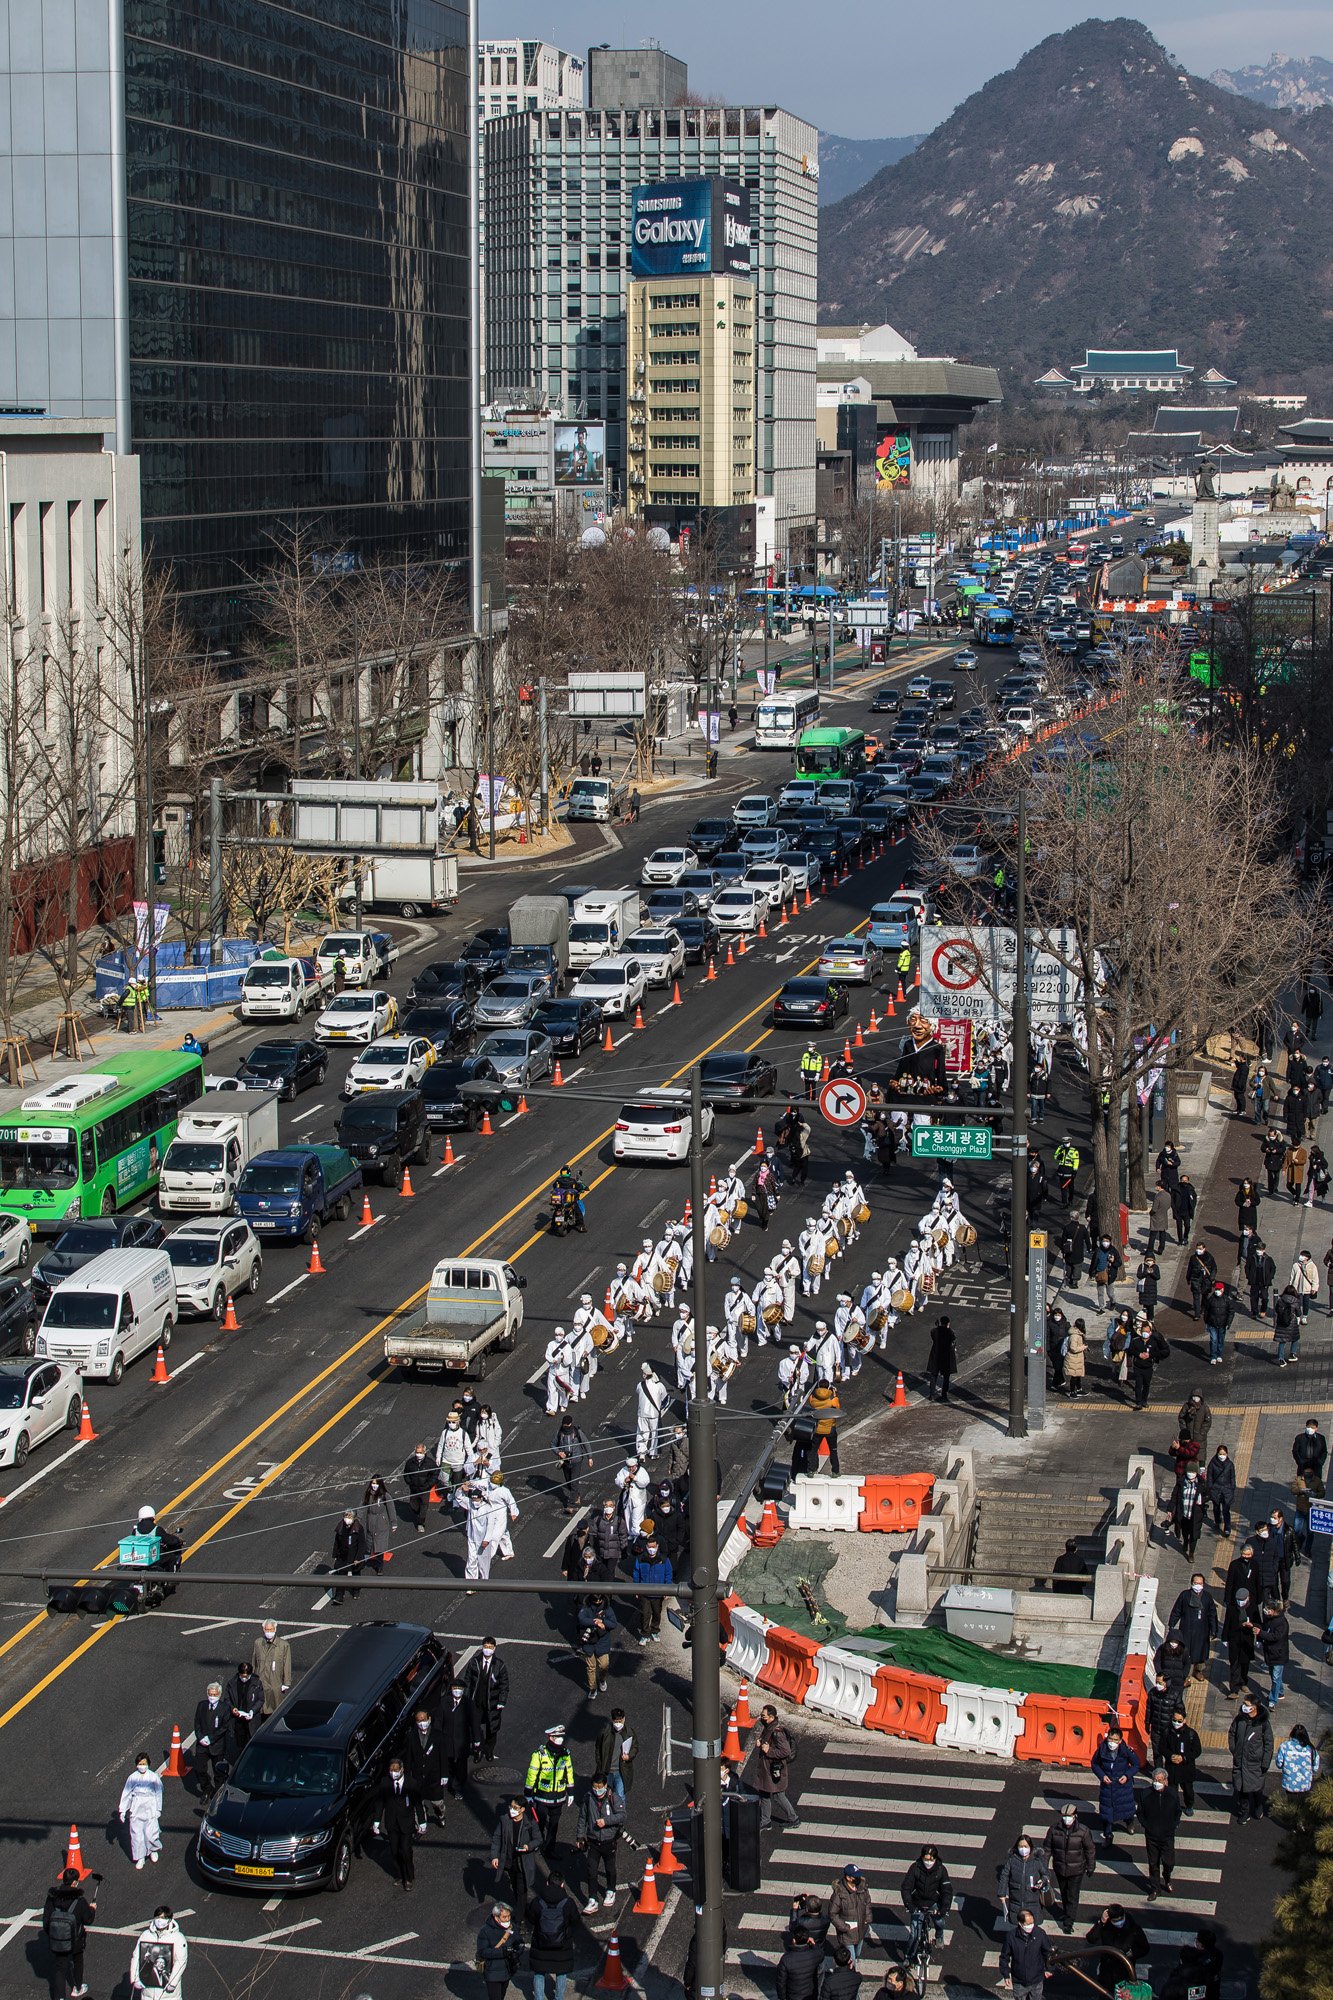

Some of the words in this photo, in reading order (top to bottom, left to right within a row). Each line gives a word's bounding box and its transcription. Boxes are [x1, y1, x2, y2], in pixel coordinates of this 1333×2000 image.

[637, 197, 682, 212] SAMSUNG
[635, 216, 706, 248] Galaxy
[933, 994, 984, 1008] 전방200m
[932, 1008, 960, 1017] (자전거
[963, 1008, 983, 1017] 허용)
[0, 1129, 17, 1140] 7011
[932, 1130, 987, 1145] 청계광장
[932, 1143, 967, 1155] Cheonggye
[969, 1145, 987, 1154] Plaza
[1312, 1510, 1333, 1520] 세종대
